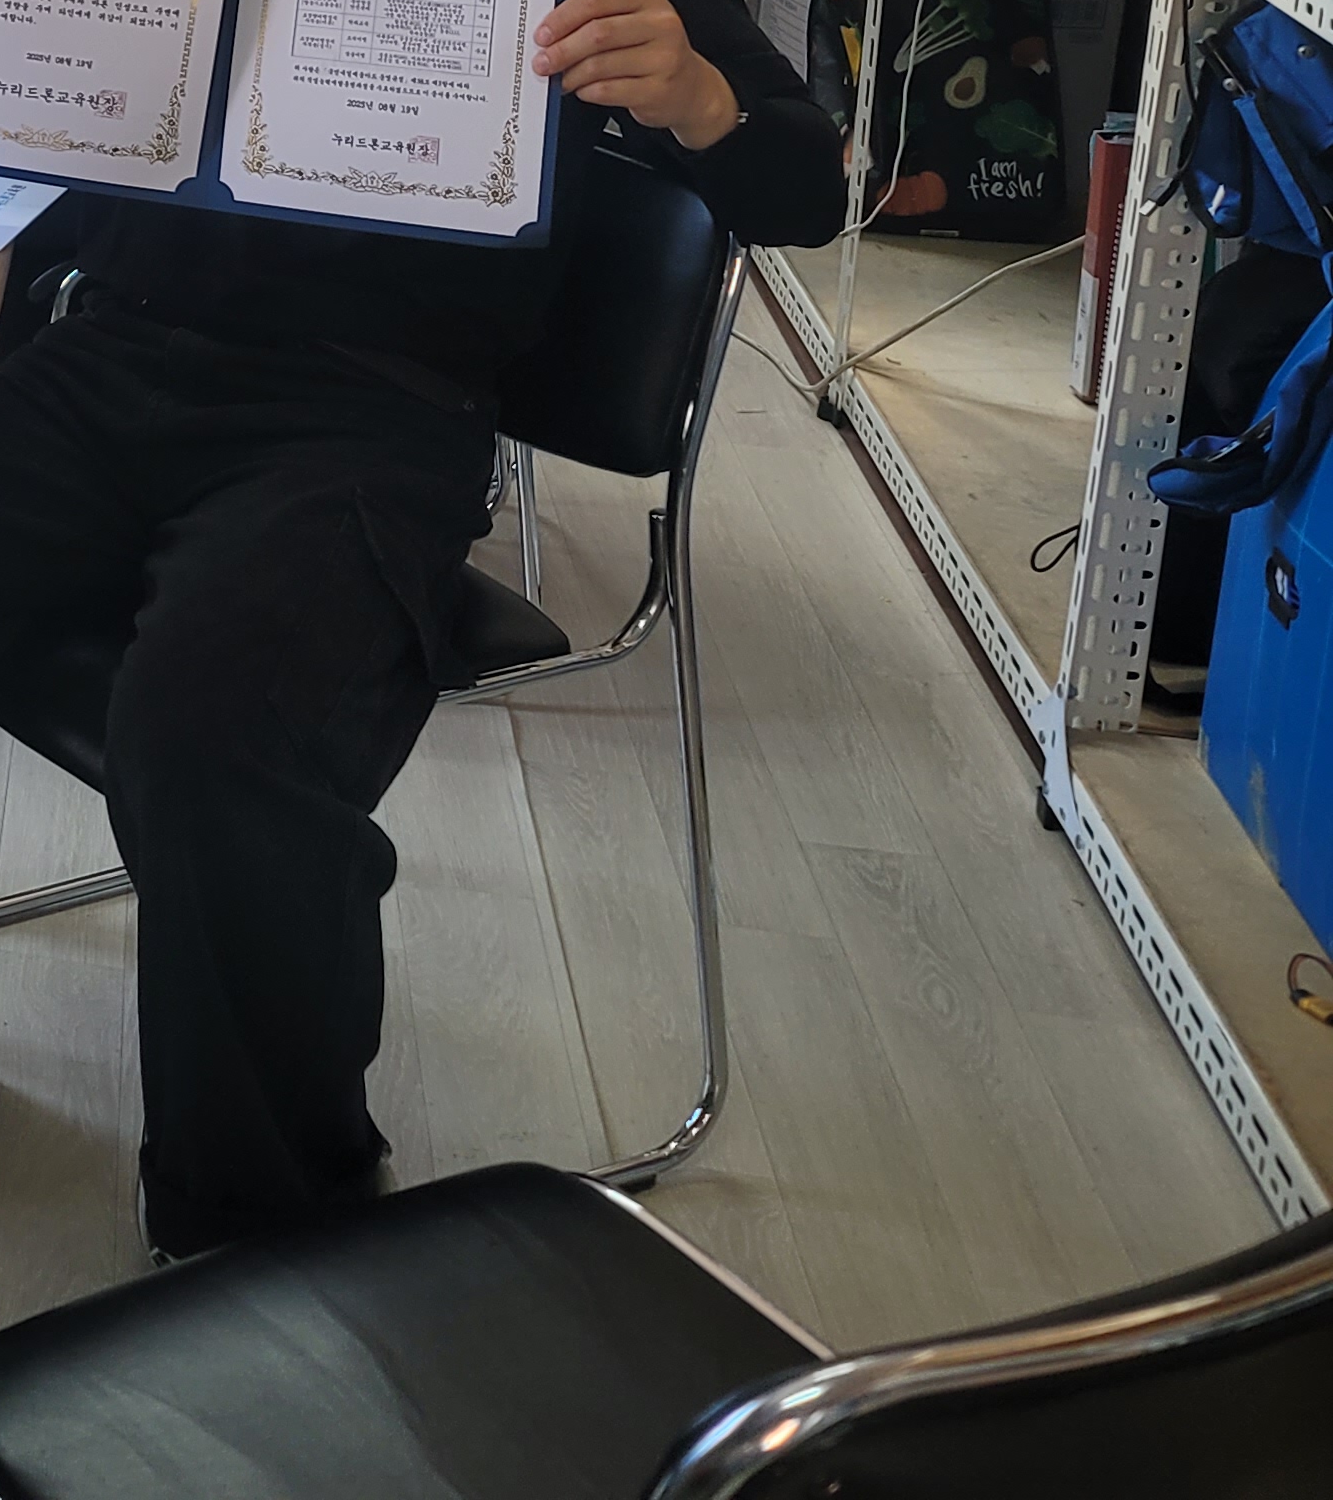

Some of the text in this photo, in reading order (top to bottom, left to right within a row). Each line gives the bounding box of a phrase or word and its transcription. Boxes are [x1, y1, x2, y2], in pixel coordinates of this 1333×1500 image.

[977, 158, 1017, 180] I am
[967, 172, 1044, 200] fresh!
